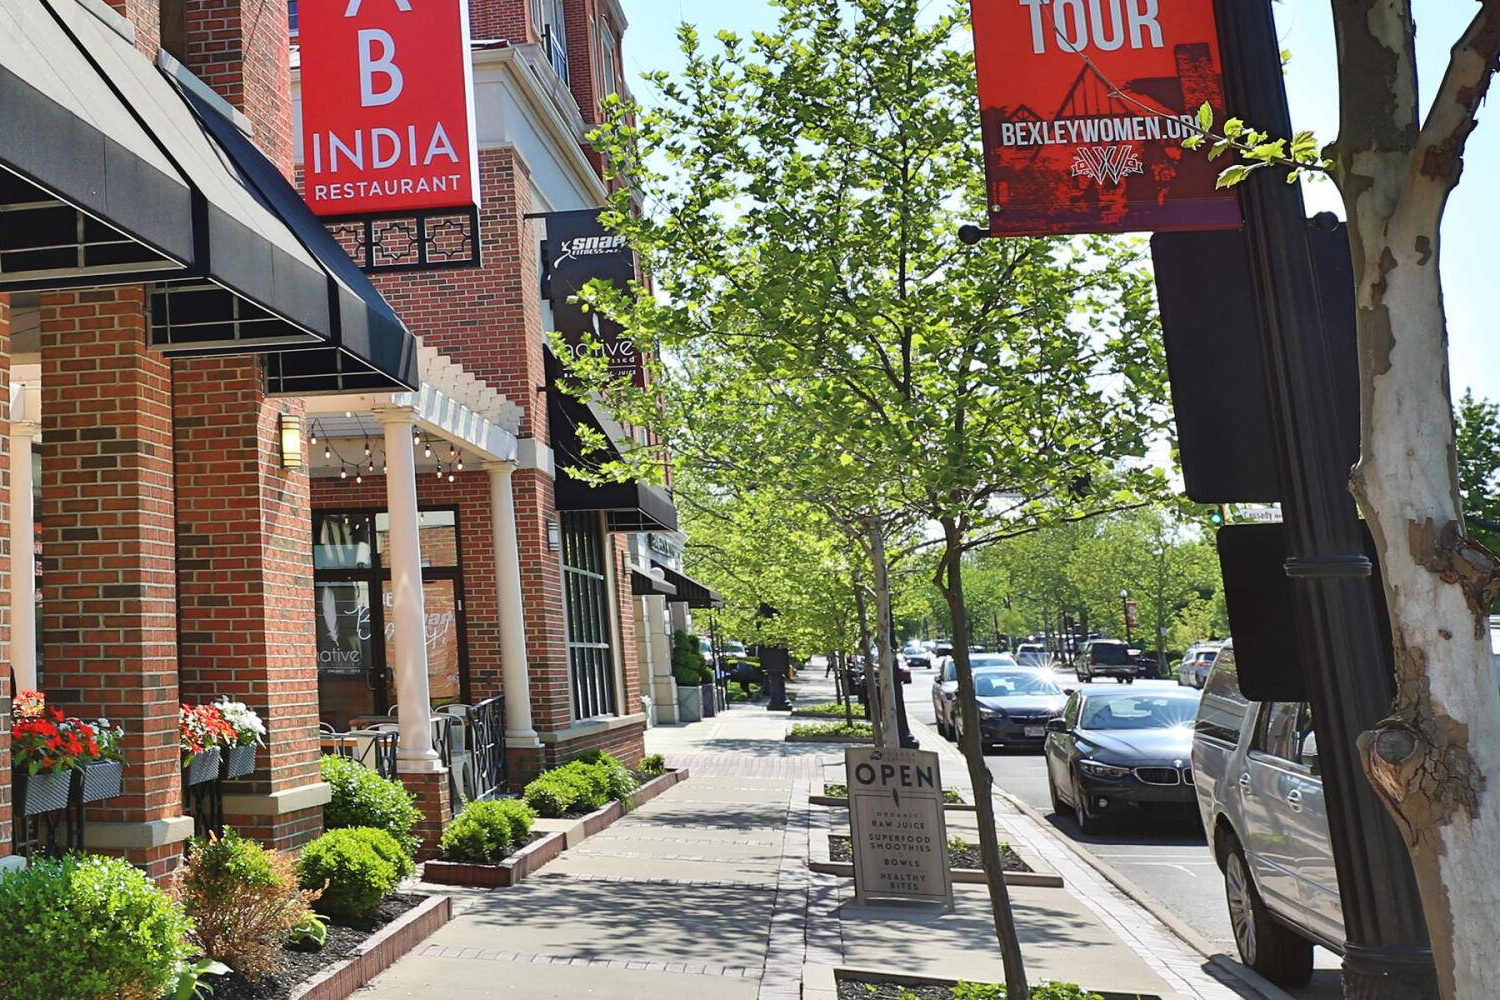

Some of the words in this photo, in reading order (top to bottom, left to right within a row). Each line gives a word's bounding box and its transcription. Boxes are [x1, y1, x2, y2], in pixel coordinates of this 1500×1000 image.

[312, 121, 459, 174] INDIA
[314, 174, 462, 201] RESTAURANT
[855, 763, 934, 788] OPEN
[871, 819, 893, 828] RAW
[896, 821, 925, 830] JUICE
[868, 832, 931, 844] SUPERFOOD
[869, 842, 931, 853] SMOOTHIES
[883, 858, 920, 868] BOWLS
[880, 872, 926, 882] HEALTHY
[890, 881, 919, 891] BITES
